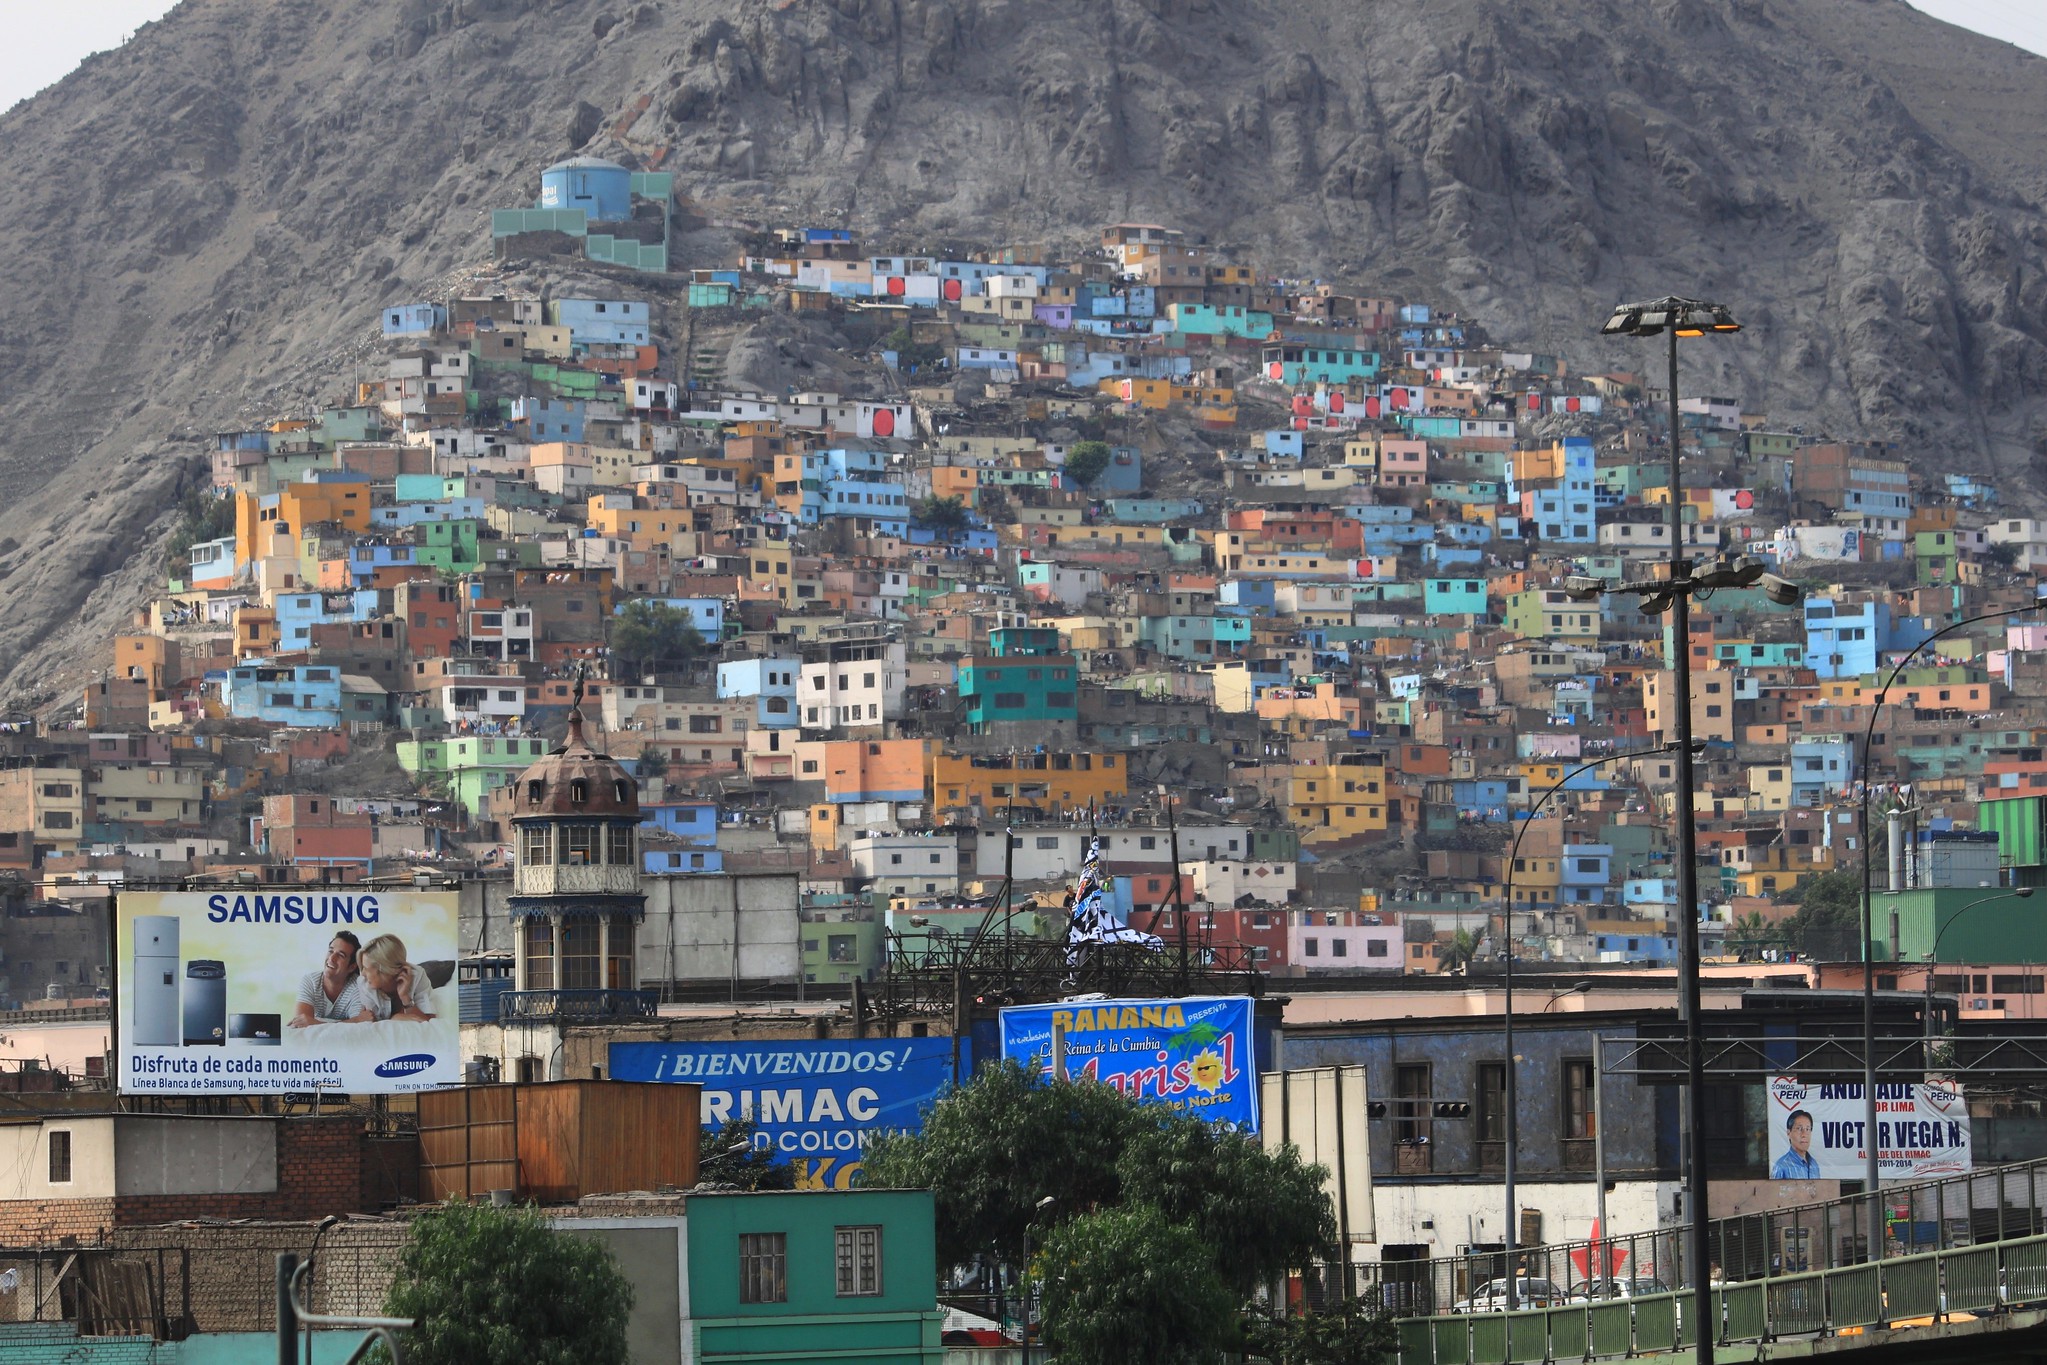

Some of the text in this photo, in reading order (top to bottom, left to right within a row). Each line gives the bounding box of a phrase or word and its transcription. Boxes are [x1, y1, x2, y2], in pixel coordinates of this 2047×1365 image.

[207, 894, 380, 924] SAMSUNG
[1052, 1003, 1228, 1033] BANANA PRESENTA
[1064, 1041, 1092, 1057] Reina
[1094, 1039, 1106, 1053] de
[1109, 1038, 1119, 1053] la
[1121, 1036, 1161, 1053] Cumbia
[132, 1055, 341, 1073] Disfruta de cada momento.
[381, 1061, 430, 1071] SAMSUNG
[132, 1077, 157, 1088] Línea
[159, 1077, 189, 1088] Blanca
[191, 1077, 202, 1088] de
[204, 1078, 246, 1091] Samsung,
[248, 1077, 269, 1088] hace
[271, 1078, 281, 1088] tu
[283, 1077, 301, 1088] vida
[1820, 1084, 1915, 1100] ANDADE
[701, 1087, 880, 1124] RIMAC
[1188, 1092, 1232, 1109] Norte
[1875, 1101, 1915, 1112] OR LIMA
[1821, 1120, 1966, 1149] VICTR VEGA N.
[1891, 1150, 1904, 1159] DEL
[1905, 1150, 1931, 1159] RIMAC
[1878, 1160, 1913, 1168] 2011-2014
